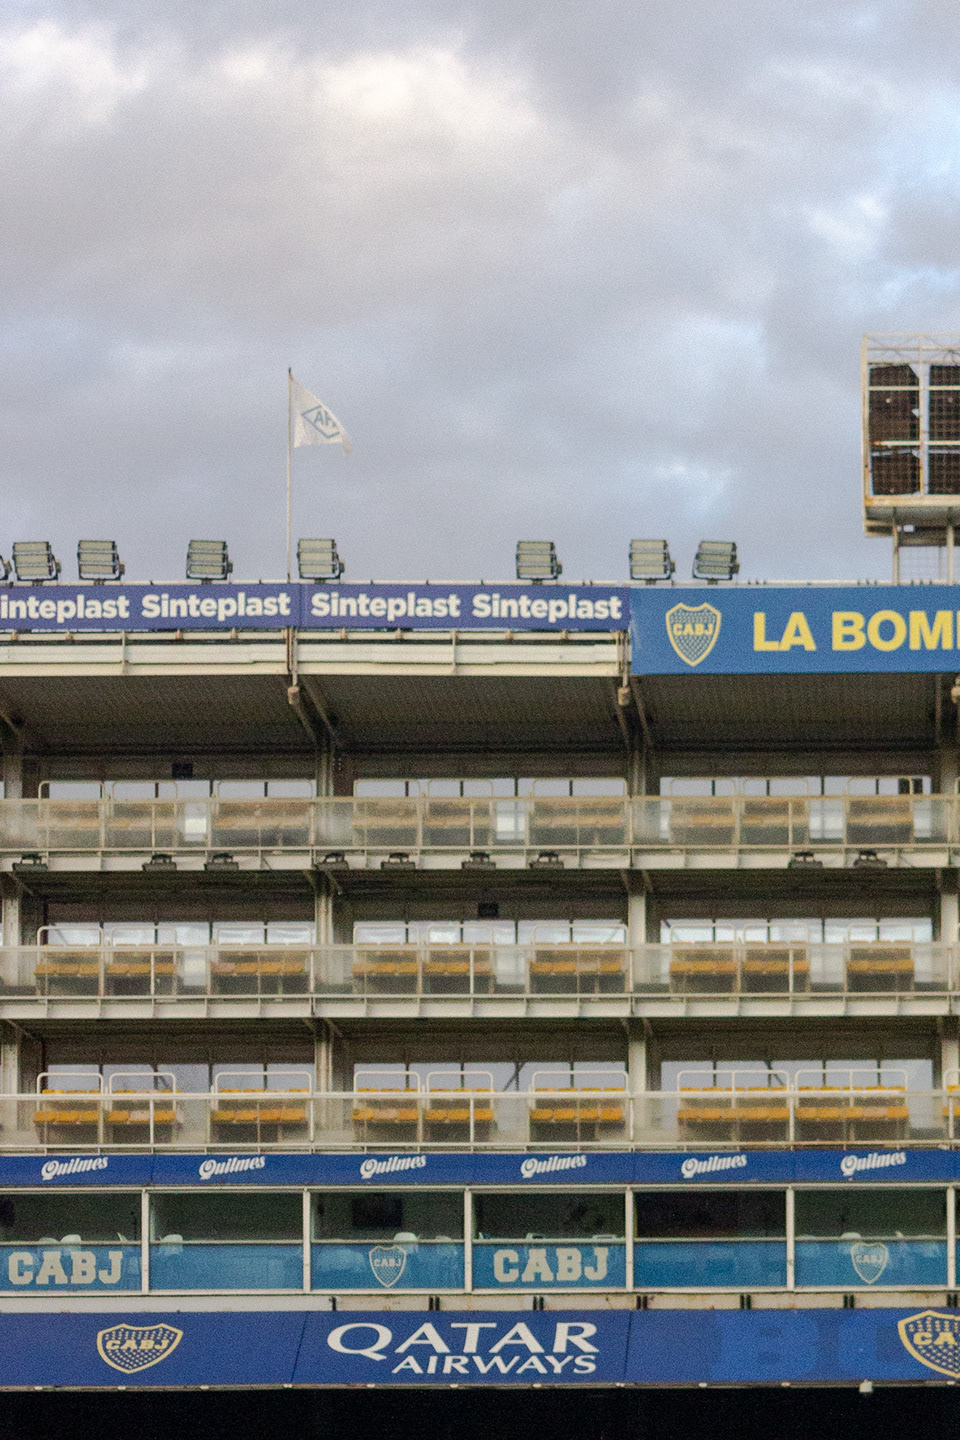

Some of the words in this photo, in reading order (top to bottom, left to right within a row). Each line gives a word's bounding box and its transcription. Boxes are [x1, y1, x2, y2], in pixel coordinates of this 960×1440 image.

[141, 593, 291, 622] Sinteplast
[310, 593, 461, 622] Sinteplast
[472, 593, 622, 623] Sinteplast
[672, 623, 714, 636] CABJ
[753, 611, 817, 652] LA
[41, 1156, 108, 1181] Quilmes
[199, 1156, 266, 1180] Quilmes
[360, 1155, 427, 1179] Quilmes
[520, 1154, 587, 1179] Quilmes
[681, 1154, 747, 1179] Quilmes
[840, 1152, 906, 1178] Quilmes
[8, 1251, 123, 1285] CABJ
[493, 1248, 609, 1284] CABJ
[105, 1339, 170, 1350] CABJ
[327, 1322, 599, 1361] QATAR
[391, 1355, 597, 1374] AIRWAYS
